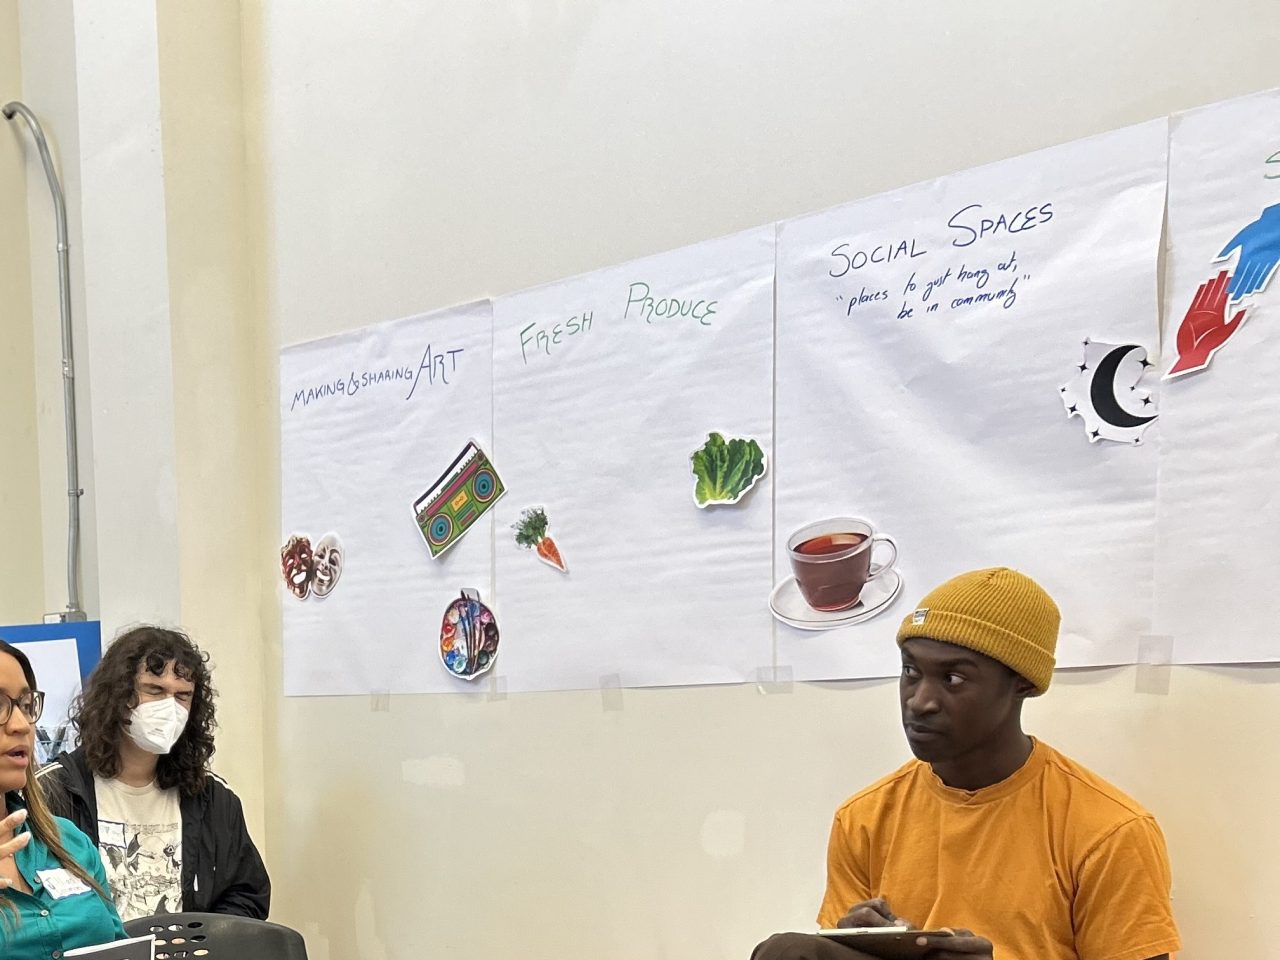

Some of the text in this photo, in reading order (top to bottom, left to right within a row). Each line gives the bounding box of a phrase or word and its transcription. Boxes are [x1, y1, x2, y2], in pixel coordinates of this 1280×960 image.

[829, 203, 1053, 278] SOCIAL SPACES
[897, 301, 913, 319] be
[926, 303, 939, 313] in
[903, 272, 917, 295] to
[922, 267, 952, 301] just
[957, 264, 990, 289] hang
[520, 282, 718, 364] FRESH PRODUCE
[291, 378, 345, 412] MAKING
[361, 366, 413, 387] SHARING
[406, 344, 464, 401] ART
